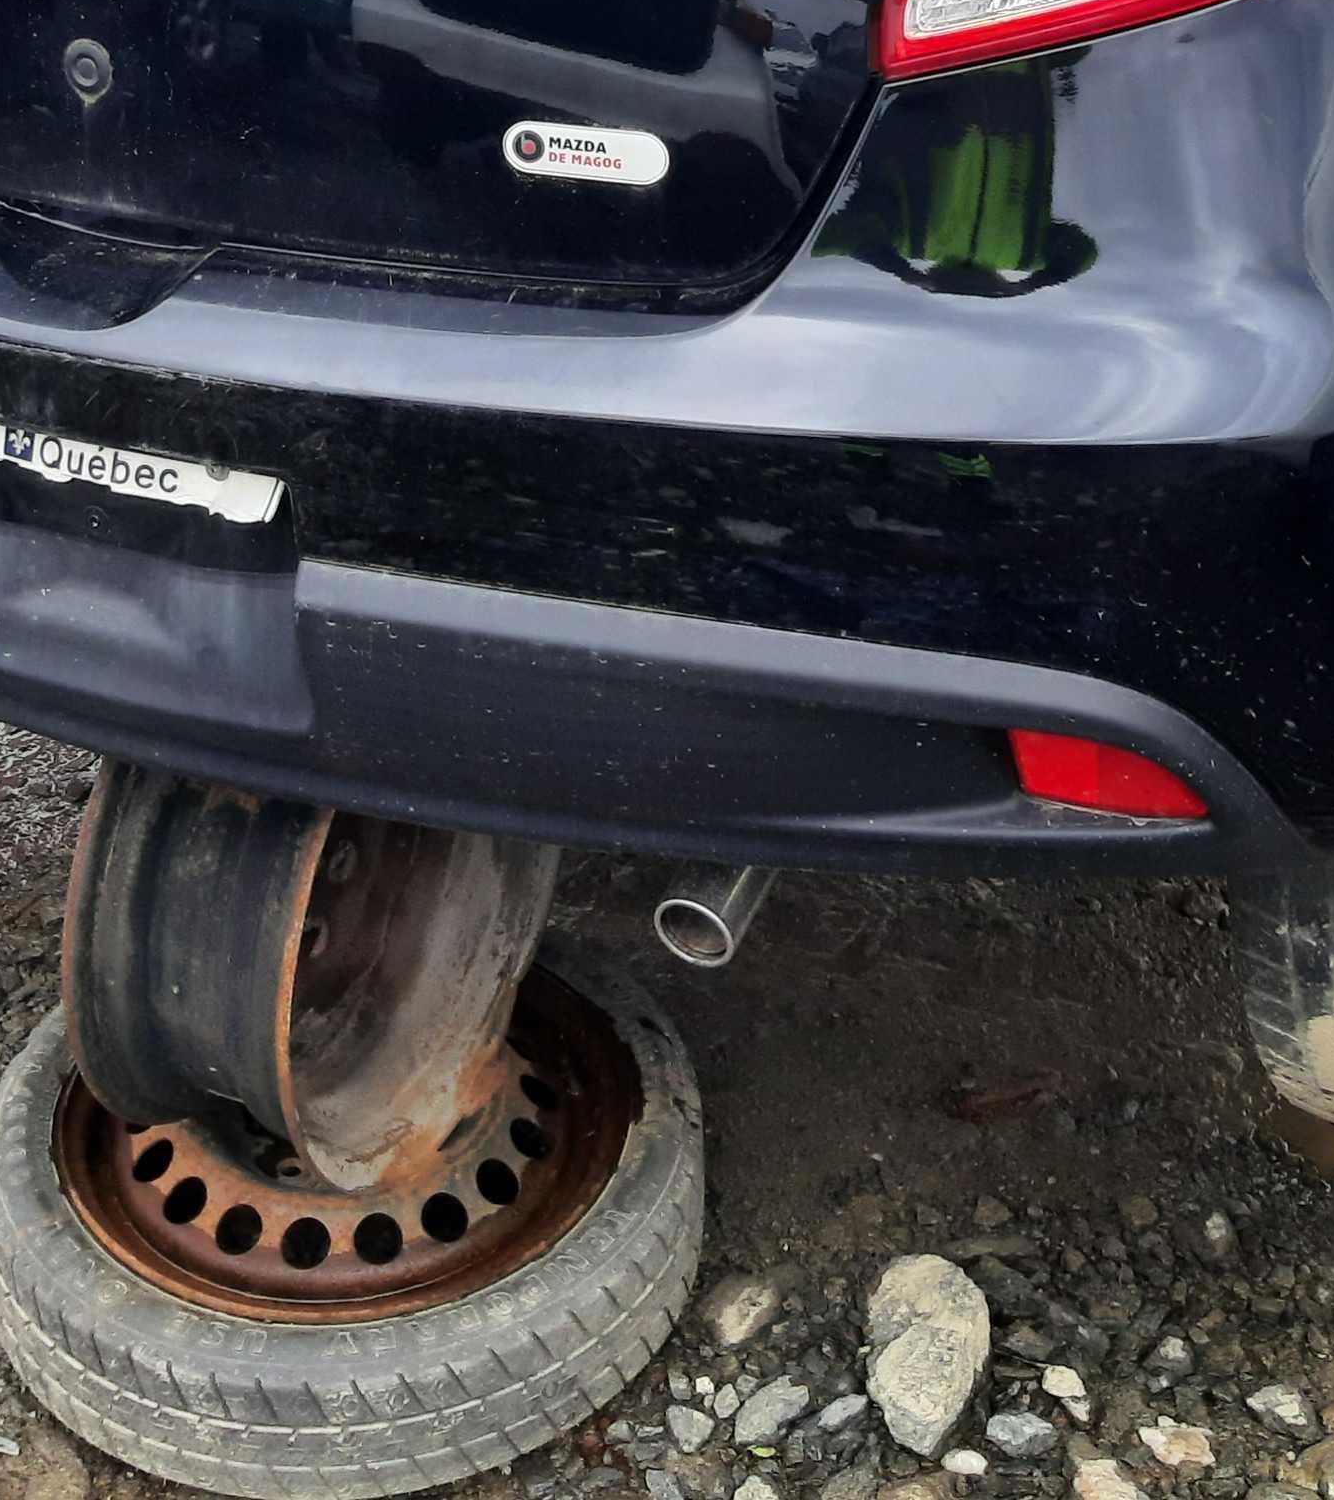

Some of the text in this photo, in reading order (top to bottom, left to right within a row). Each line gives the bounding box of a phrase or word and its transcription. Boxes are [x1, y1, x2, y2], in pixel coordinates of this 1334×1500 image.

[548, 136, 606, 153] MAZDA
[548, 151, 622, 169] DE MAGOG
[38, 435, 180, 494] Québec
